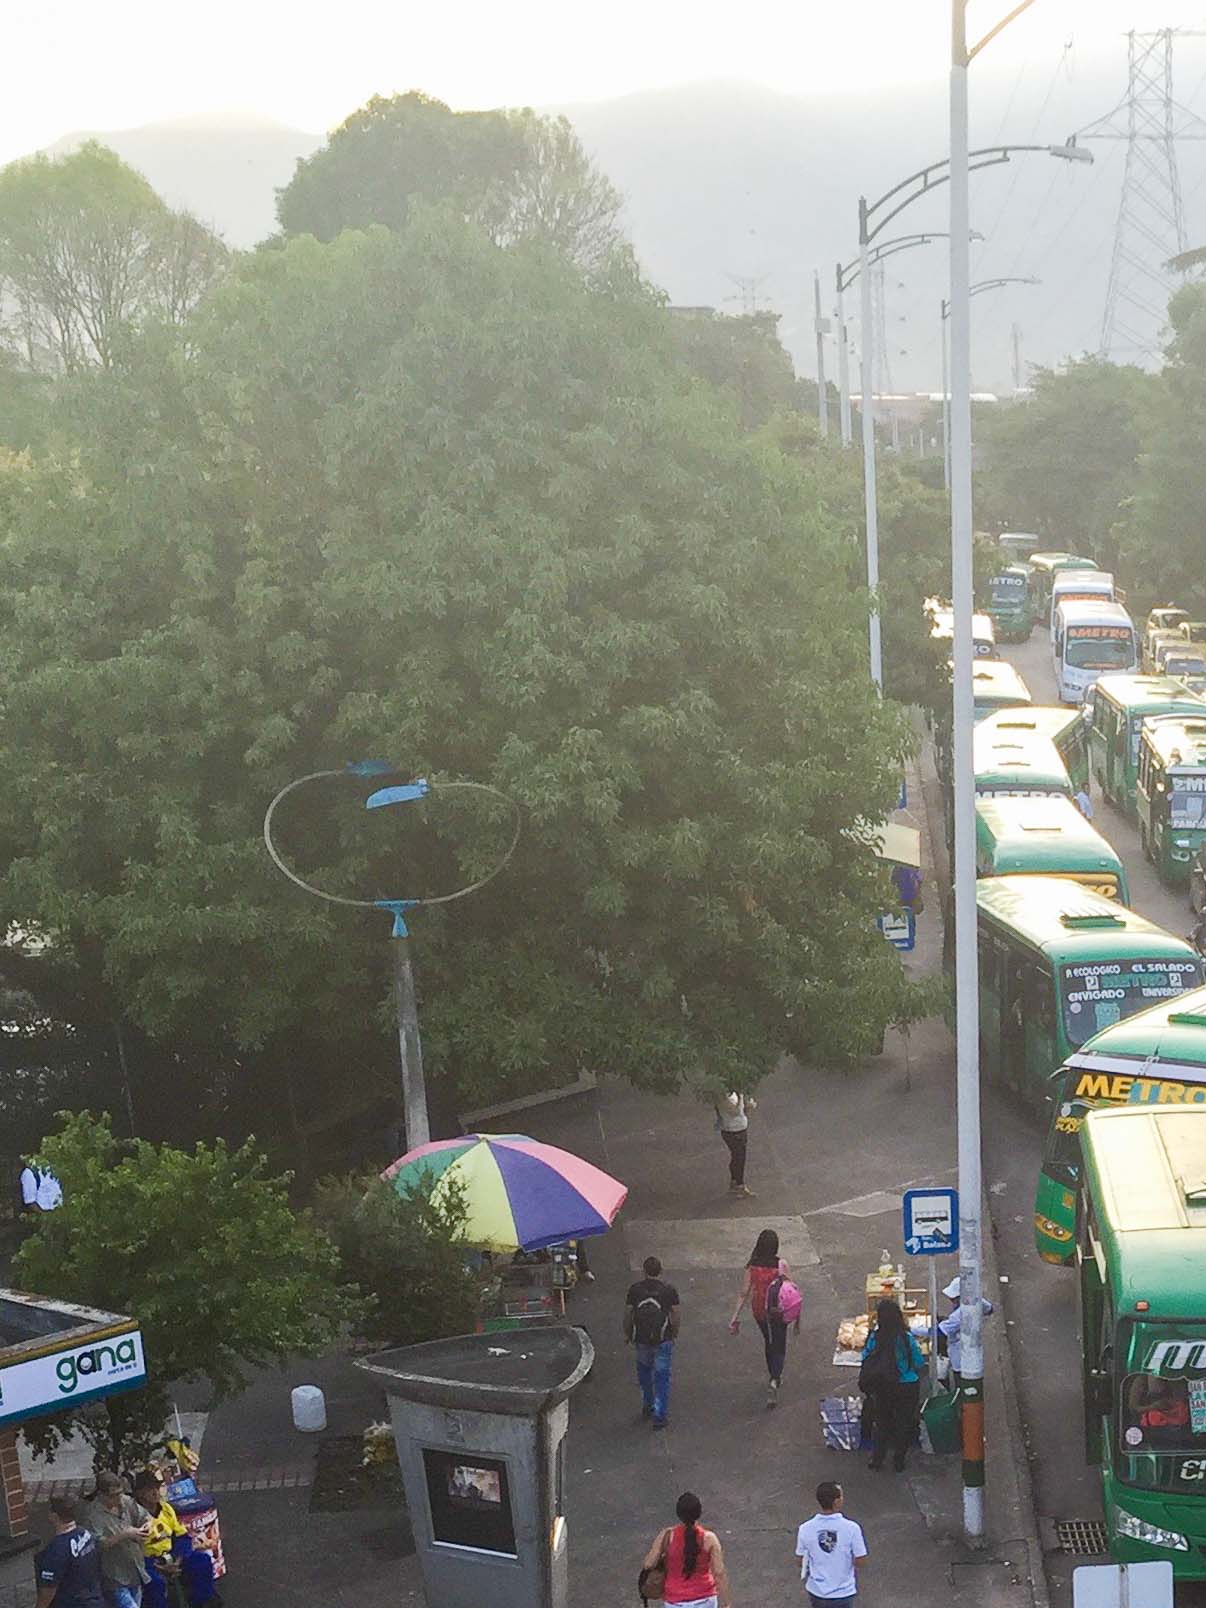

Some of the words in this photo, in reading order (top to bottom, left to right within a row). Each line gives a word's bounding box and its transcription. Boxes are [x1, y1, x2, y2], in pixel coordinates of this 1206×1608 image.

[1131, 964, 1146, 973] EL
[1148, 963, 1196, 973] SALADO
[1067, 989, 1126, 1002] ENVIGADO
[56, 1339, 136, 1393] gana
